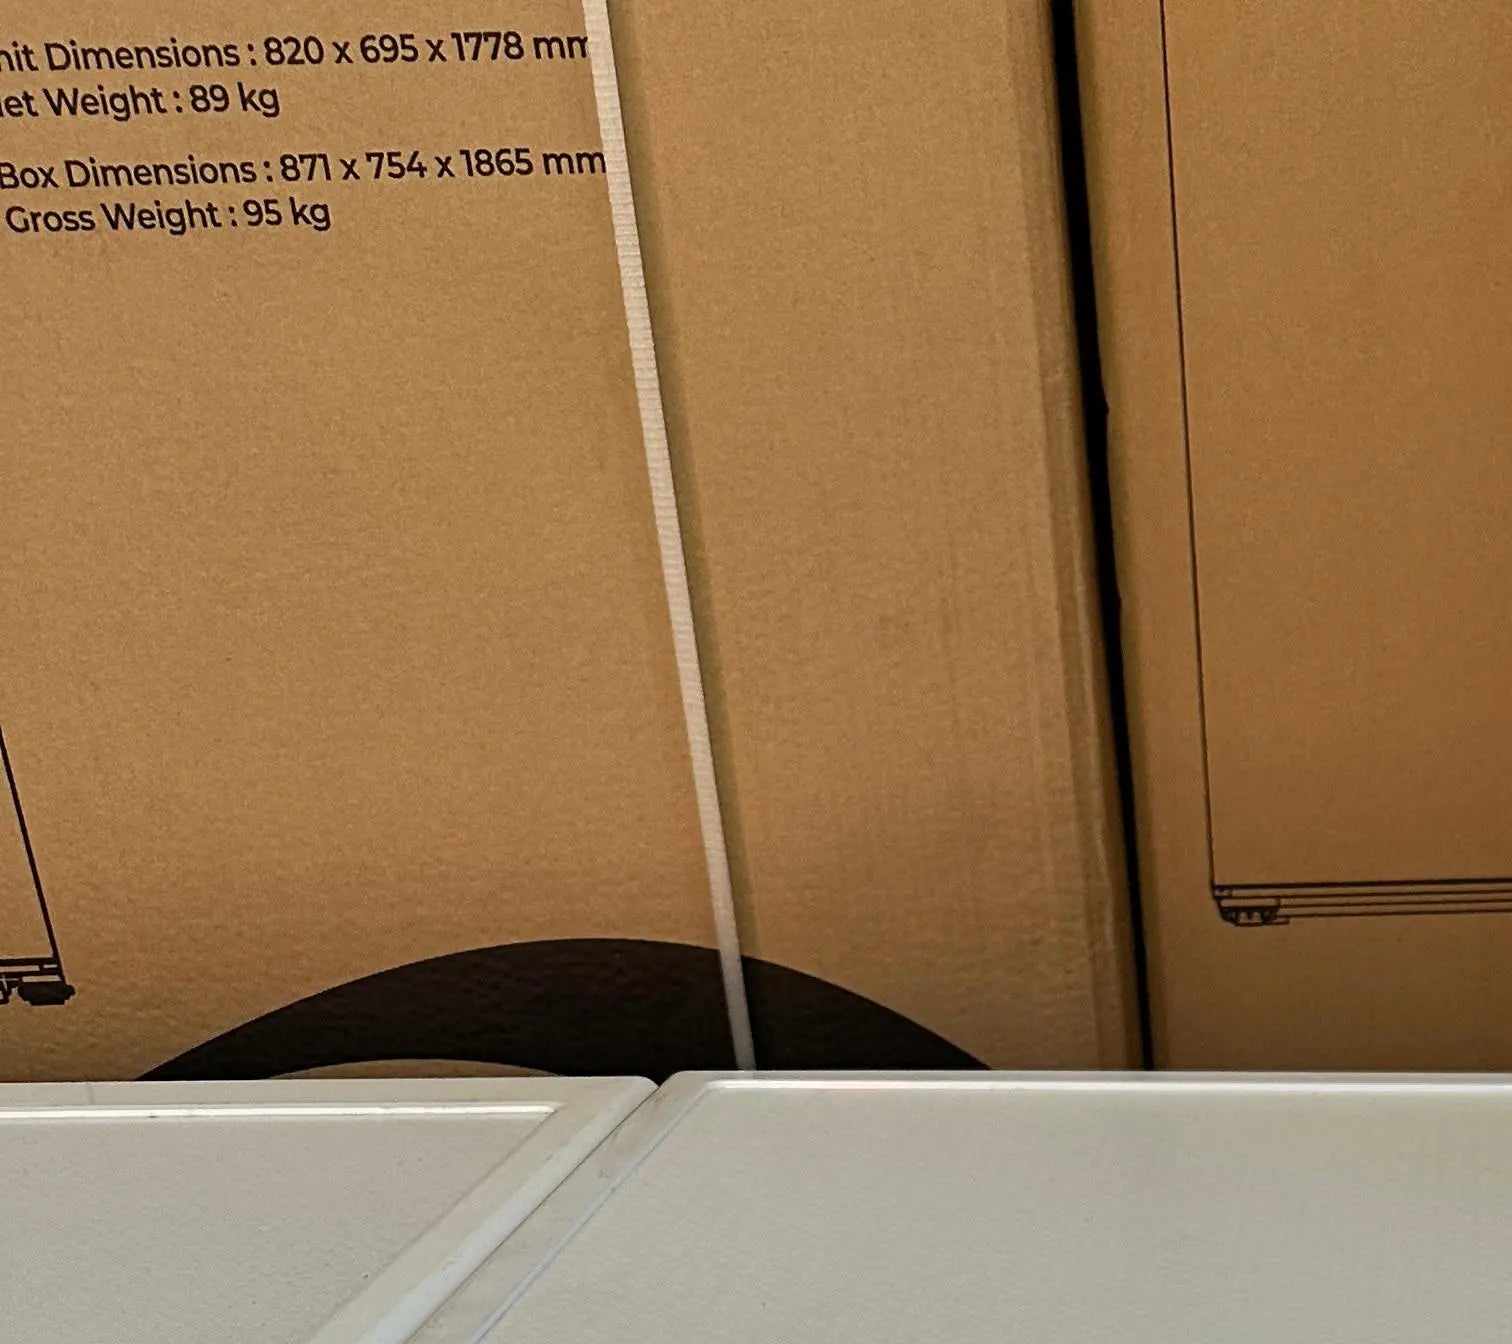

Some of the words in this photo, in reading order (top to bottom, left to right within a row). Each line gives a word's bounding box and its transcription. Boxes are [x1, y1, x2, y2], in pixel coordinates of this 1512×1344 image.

[44, 37, 240, 71] Dimensions
[264, 36, 324, 65] 820
[332, 42, 353, 64] x
[360, 34, 418, 63] 695
[425, 39, 447, 62] x
[451, 31, 524, 61] 1778
[42, 85, 167, 121] Weight
[189, 84, 229, 112] 89
[237, 82, 280, 117] kg
[0, 162, 59, 189] Box
[64, 154, 257, 187] Dimensions
[280, 154, 331, 181] 871
[340, 159, 360, 180] x
[365, 151, 427, 179] 754
[434, 156, 455, 177] x
[460, 148, 533, 177] 1865
[542, 152, 606, 175] mm
[6, 206, 95, 233] Gross
[100, 200, 222, 235] Weight
[243, 199, 282, 226] 95
[289, 197, 331, 231] kg
